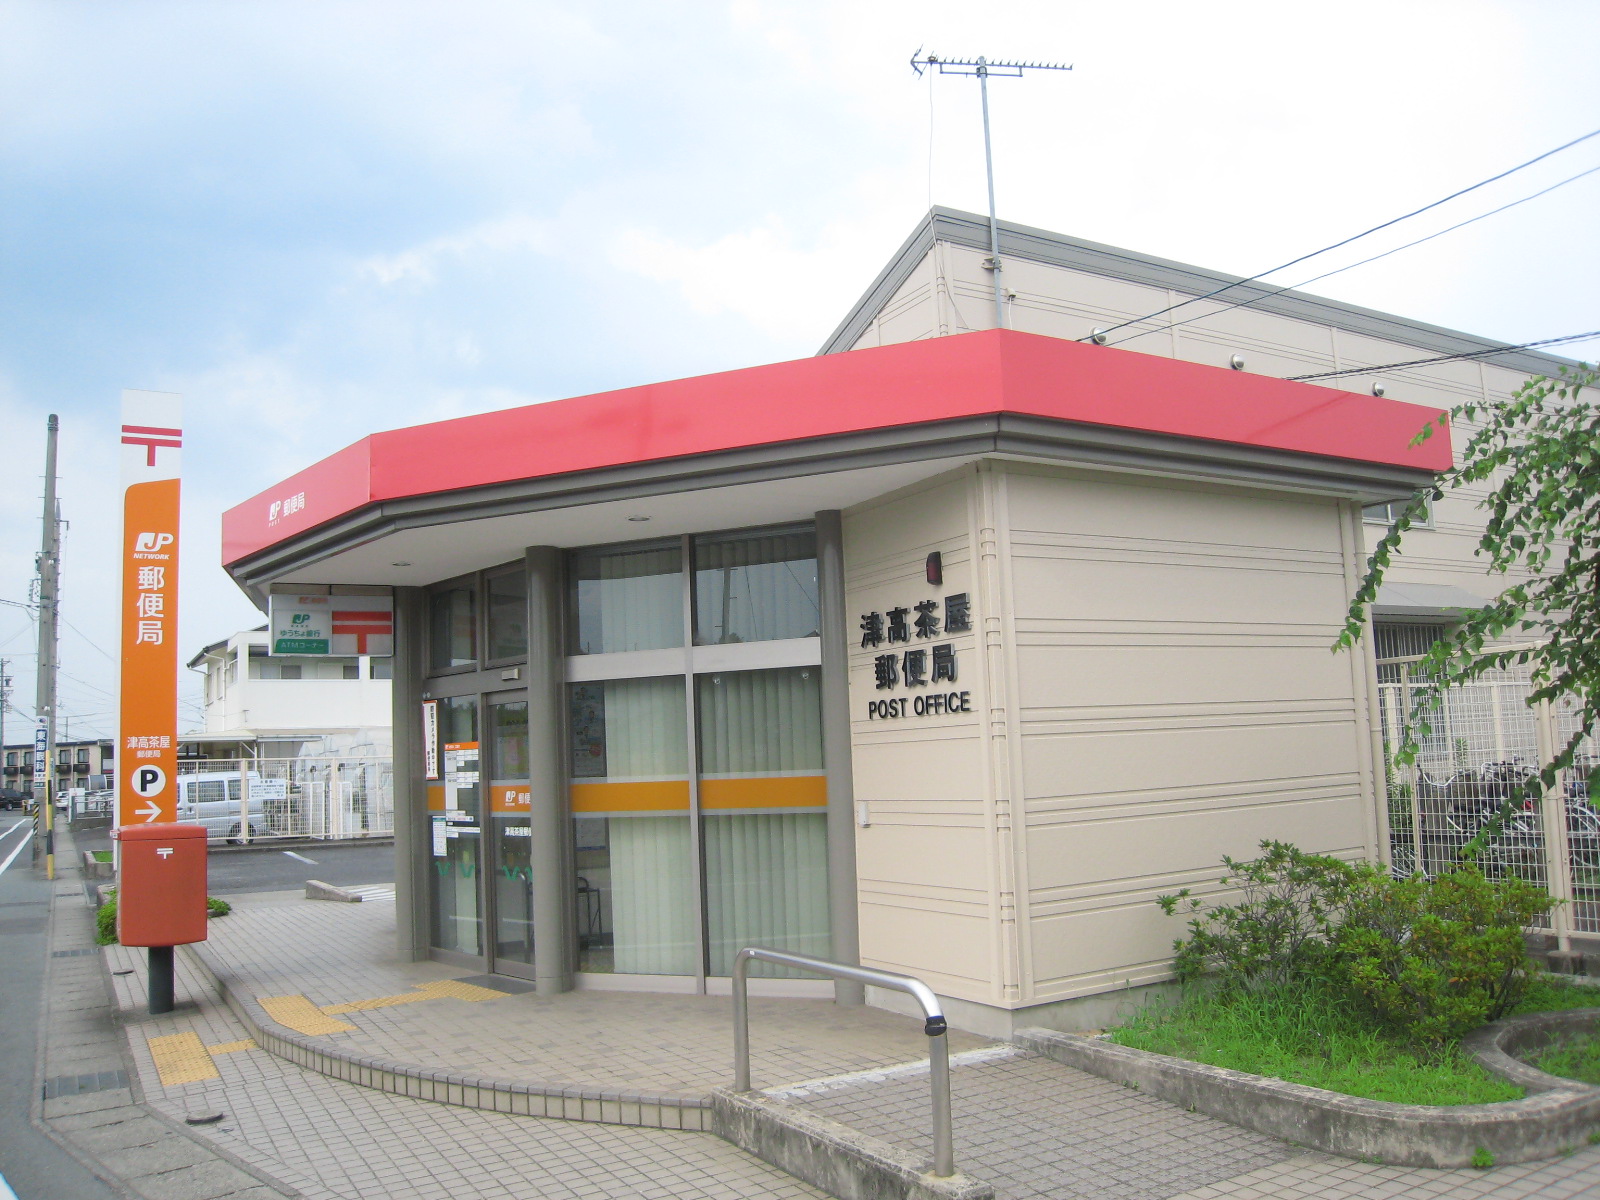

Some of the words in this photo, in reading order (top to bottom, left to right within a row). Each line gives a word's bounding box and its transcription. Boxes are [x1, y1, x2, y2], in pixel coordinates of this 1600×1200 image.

[283, 492, 305, 517] 郵便局
[135, 532, 174, 552] JP
[136, 566, 165, 645] 郵便局
[859, 592, 973, 649] 津高茶屋
[280, 629, 321, 638] ゆうちょ銀行
[874, 643, 958, 690] 郵便局
[869, 697, 908, 720] POST
[913, 690, 971, 717] OFFICE
[127, 735, 171, 749] 津高茶屋
[136, 749, 161, 758] 郵便局
[140, 769, 159, 792] P
